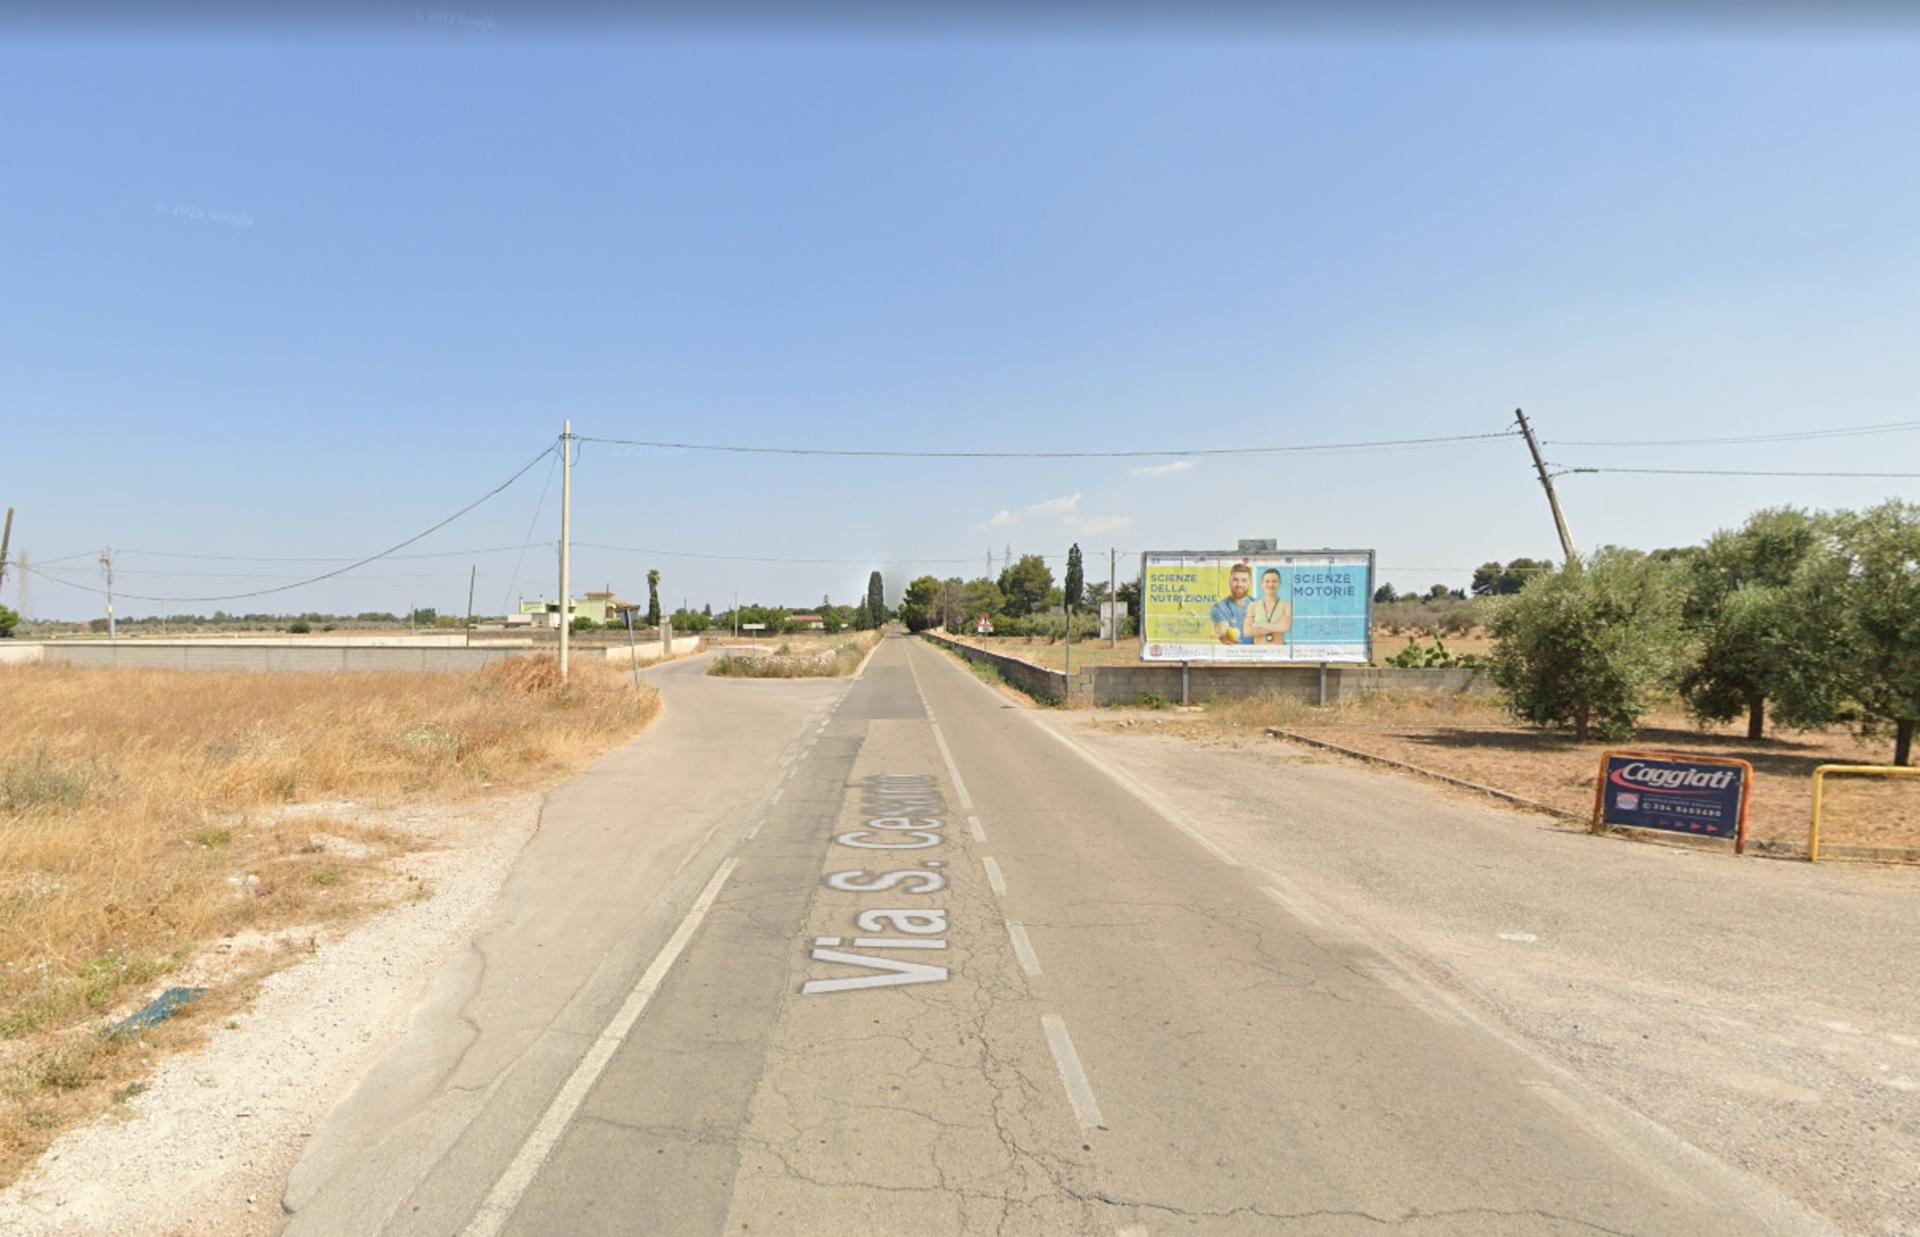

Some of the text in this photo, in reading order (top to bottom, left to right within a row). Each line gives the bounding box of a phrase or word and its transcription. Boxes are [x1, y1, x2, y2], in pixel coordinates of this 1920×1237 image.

[1151, 574, 1198, 582] SCIENZE
[1294, 574, 1351, 584] SCIENZE
[1294, 586, 1355, 597] MOTORIE
[1151, 595, 1217, 603] NUTRIZIONE
[1622, 762, 1734, 789] Caggiati
